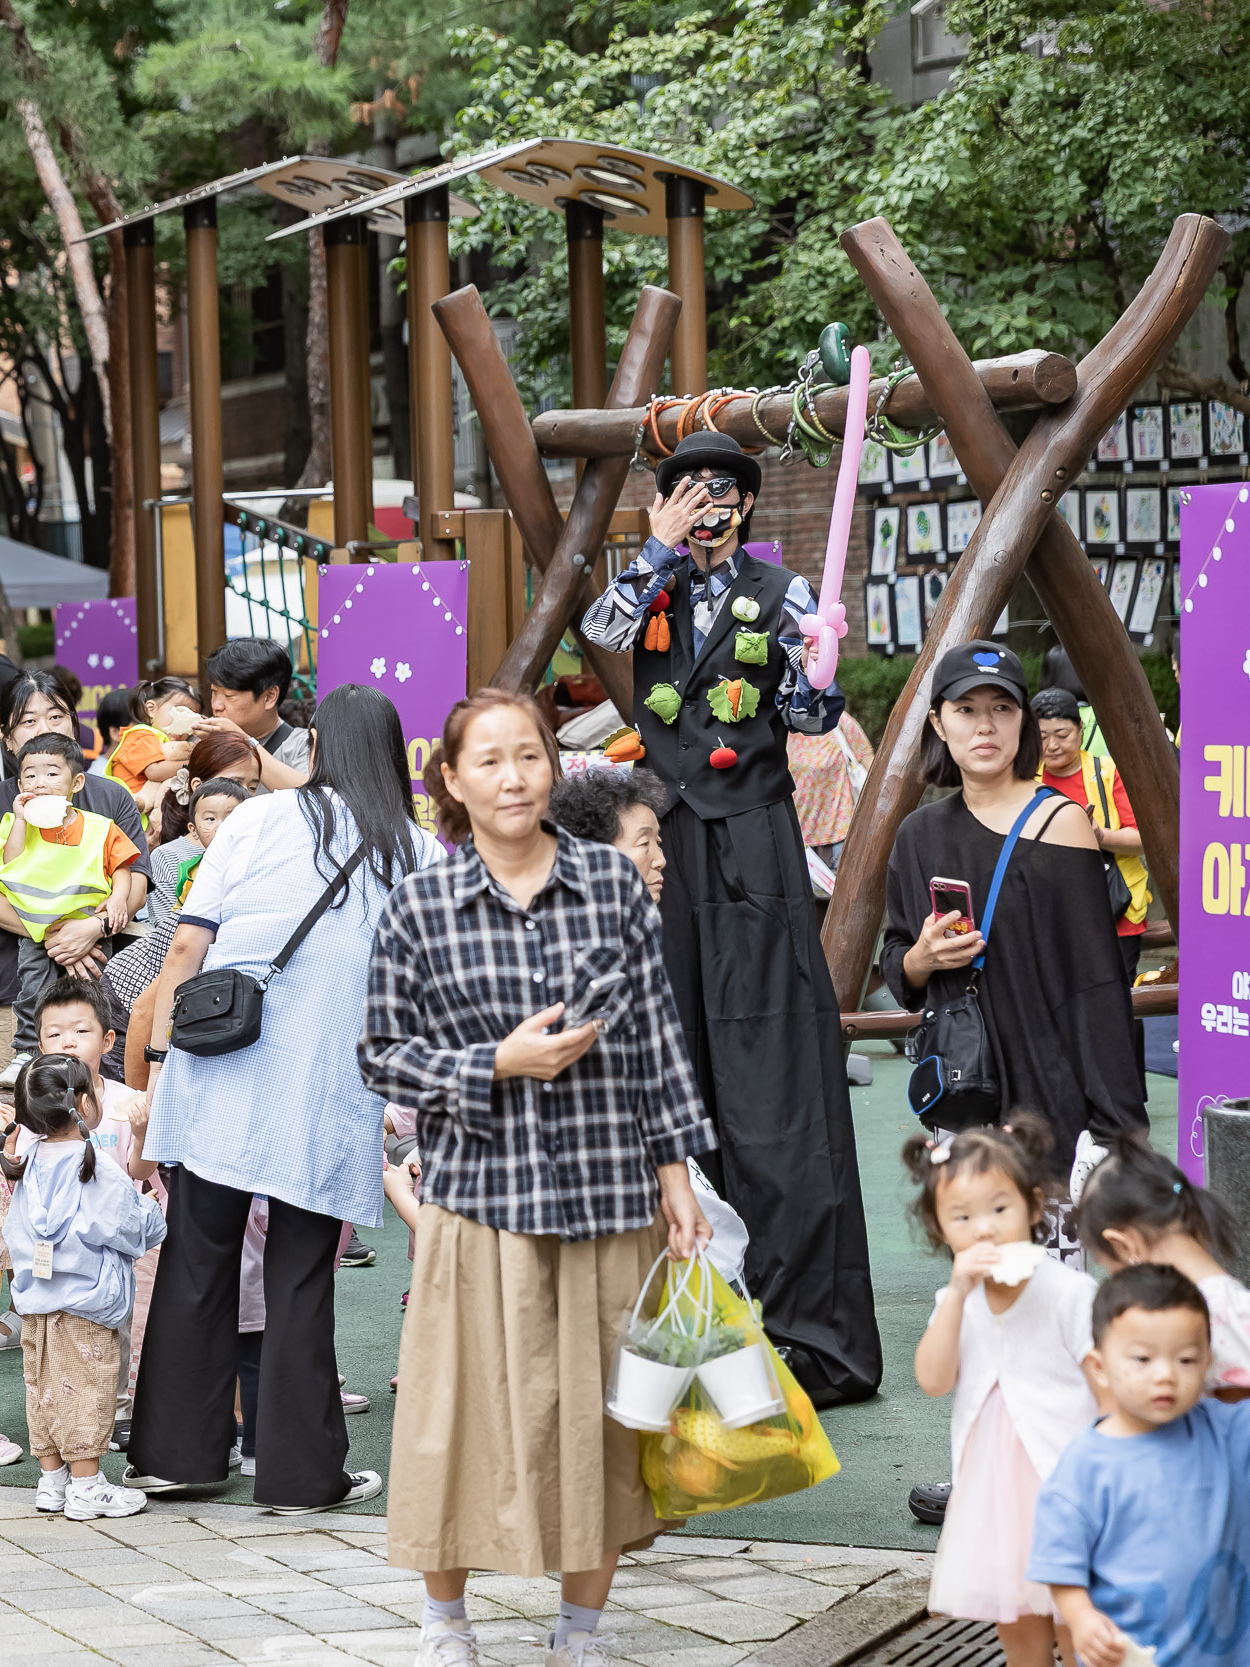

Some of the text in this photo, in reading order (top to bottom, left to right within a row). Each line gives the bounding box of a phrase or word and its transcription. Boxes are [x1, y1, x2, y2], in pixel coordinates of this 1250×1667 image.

[1203, 744, 1250, 818] 키
[1202, 841, 1250, 916] 아
[1200, 1002, 1250, 1037] 우리는
